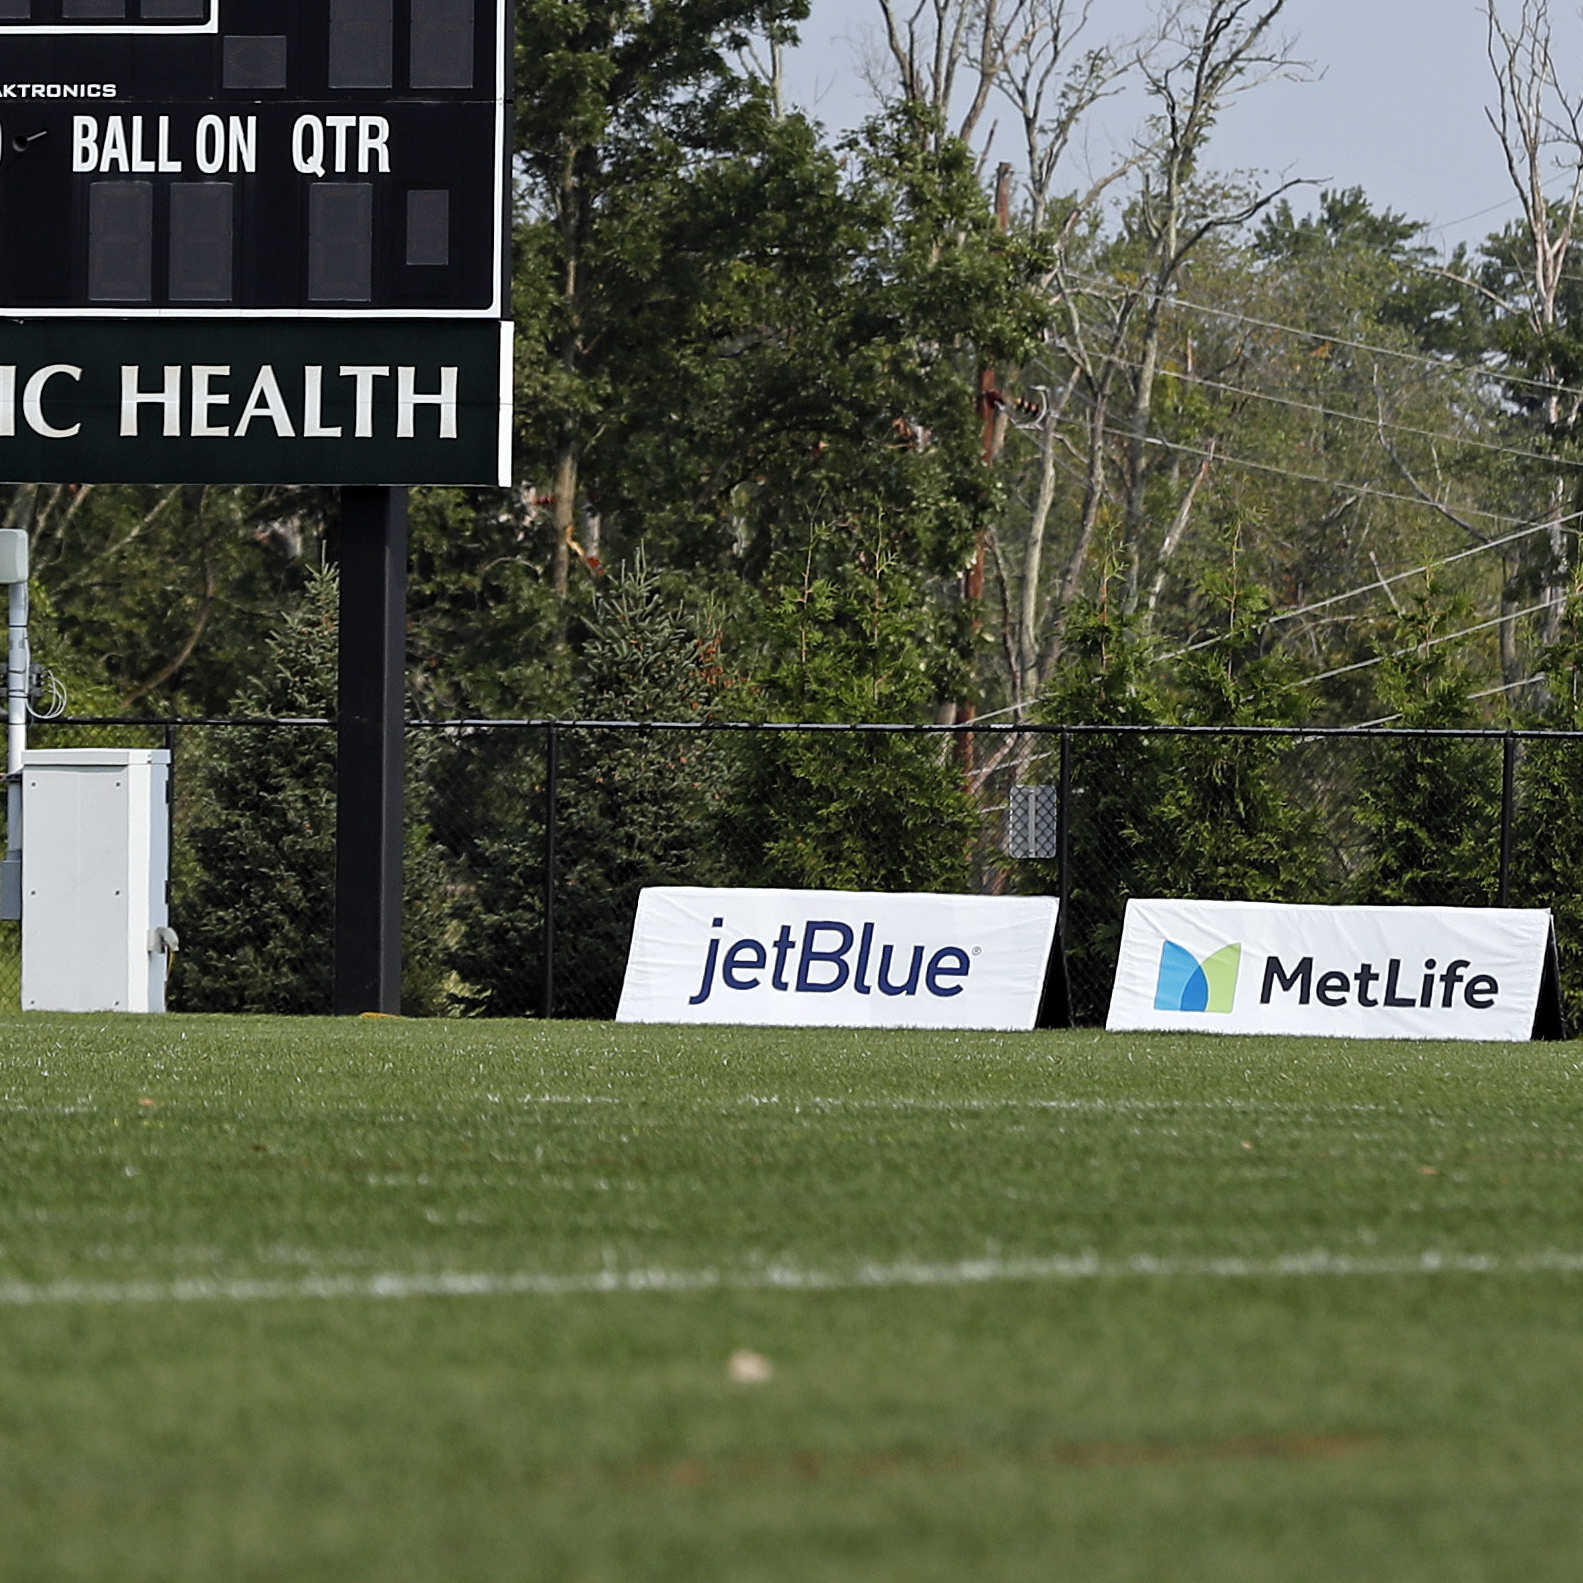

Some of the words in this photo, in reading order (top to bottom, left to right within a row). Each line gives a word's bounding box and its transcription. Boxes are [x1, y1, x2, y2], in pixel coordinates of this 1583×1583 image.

[72, 115, 182, 173] BALL
[195, 114, 257, 174] ON
[292, 114, 391, 178] QTR
[120, 365, 459, 439] HEALTH
[1260, 955, 1499, 1009] MetLife
